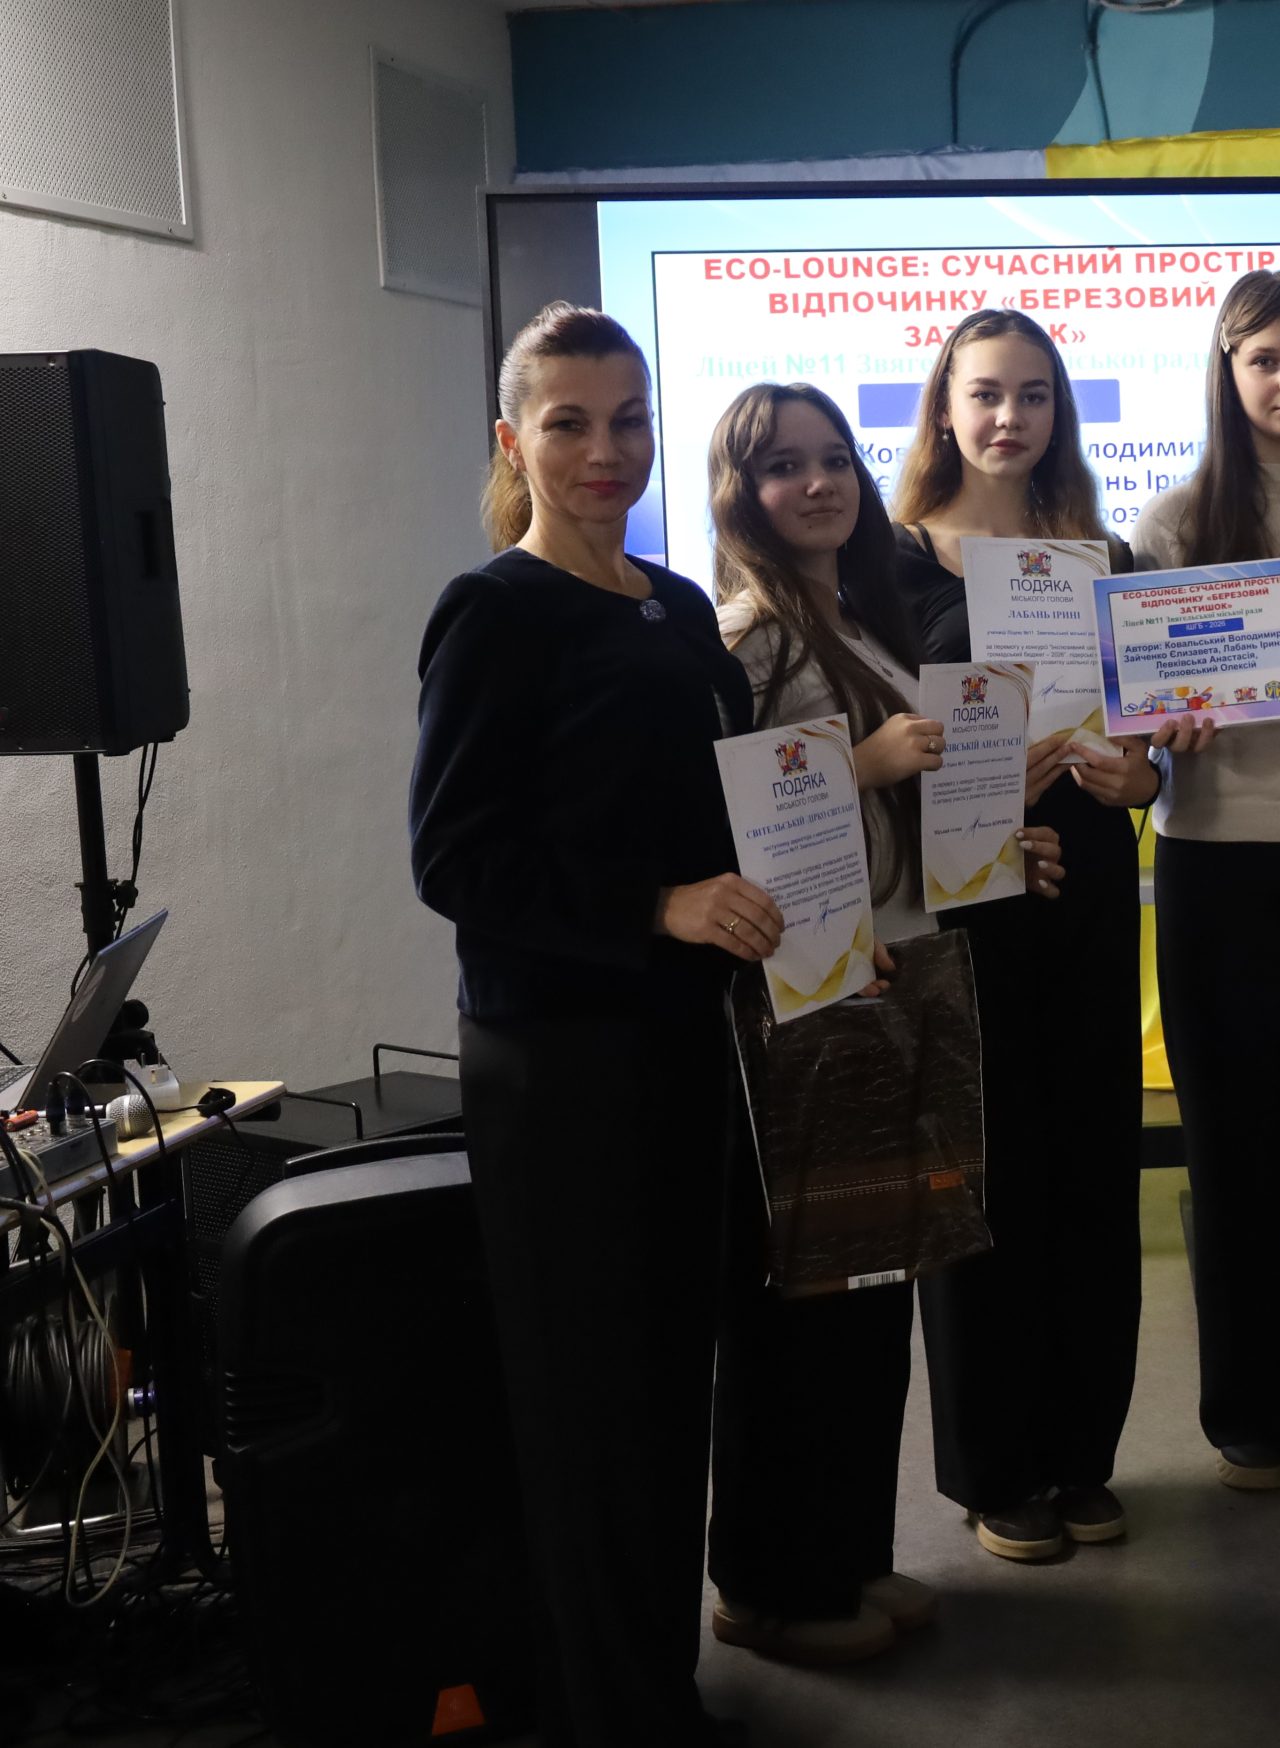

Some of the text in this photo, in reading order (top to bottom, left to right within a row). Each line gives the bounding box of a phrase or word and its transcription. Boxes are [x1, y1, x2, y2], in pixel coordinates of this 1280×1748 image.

[703, 247, 1277, 280] ECO-LOUNGE: СУЧАСНИЙ ПРОСТІР
[769, 281, 1217, 318] ВІДПОЧИНКУ «БЕРЕЗОВИЙ
[785, 350, 846, 377] №11
[1010, 579, 1072, 594] ПОДЯКА
[1122, 588, 1187, 600] ECO-LOUNGE:
[1190, 580, 1241, 593] СУЧАСНИЙ
[1141, 588, 1269, 609] ВІДПОЧИНКУ «БЕРЕЗОВИЙ
[1008, 610, 1080, 619] ЛАБАНЬ ІРИНІ
[1180, 604, 1232, 615] ЗАТИШОК»
[1145, 617, 1163, 625] №11
[1209, 621, 1226, 629] 2026
[1123, 652, 1167, 663] Зайченко
[1170, 646, 1221, 658] Єлизавета,
[1223, 643, 1258, 652] Лабань
[1125, 644, 1162, 653] Автори:
[1165, 637, 1226, 650] Ковальський
[1156, 653, 1258, 669] Левківська Анастасія,
[1159, 661, 1257, 678] Грозовський Олексій
[953, 706, 999, 723] ПОДЯКА
[773, 772, 827, 798] ПОДЯКА
